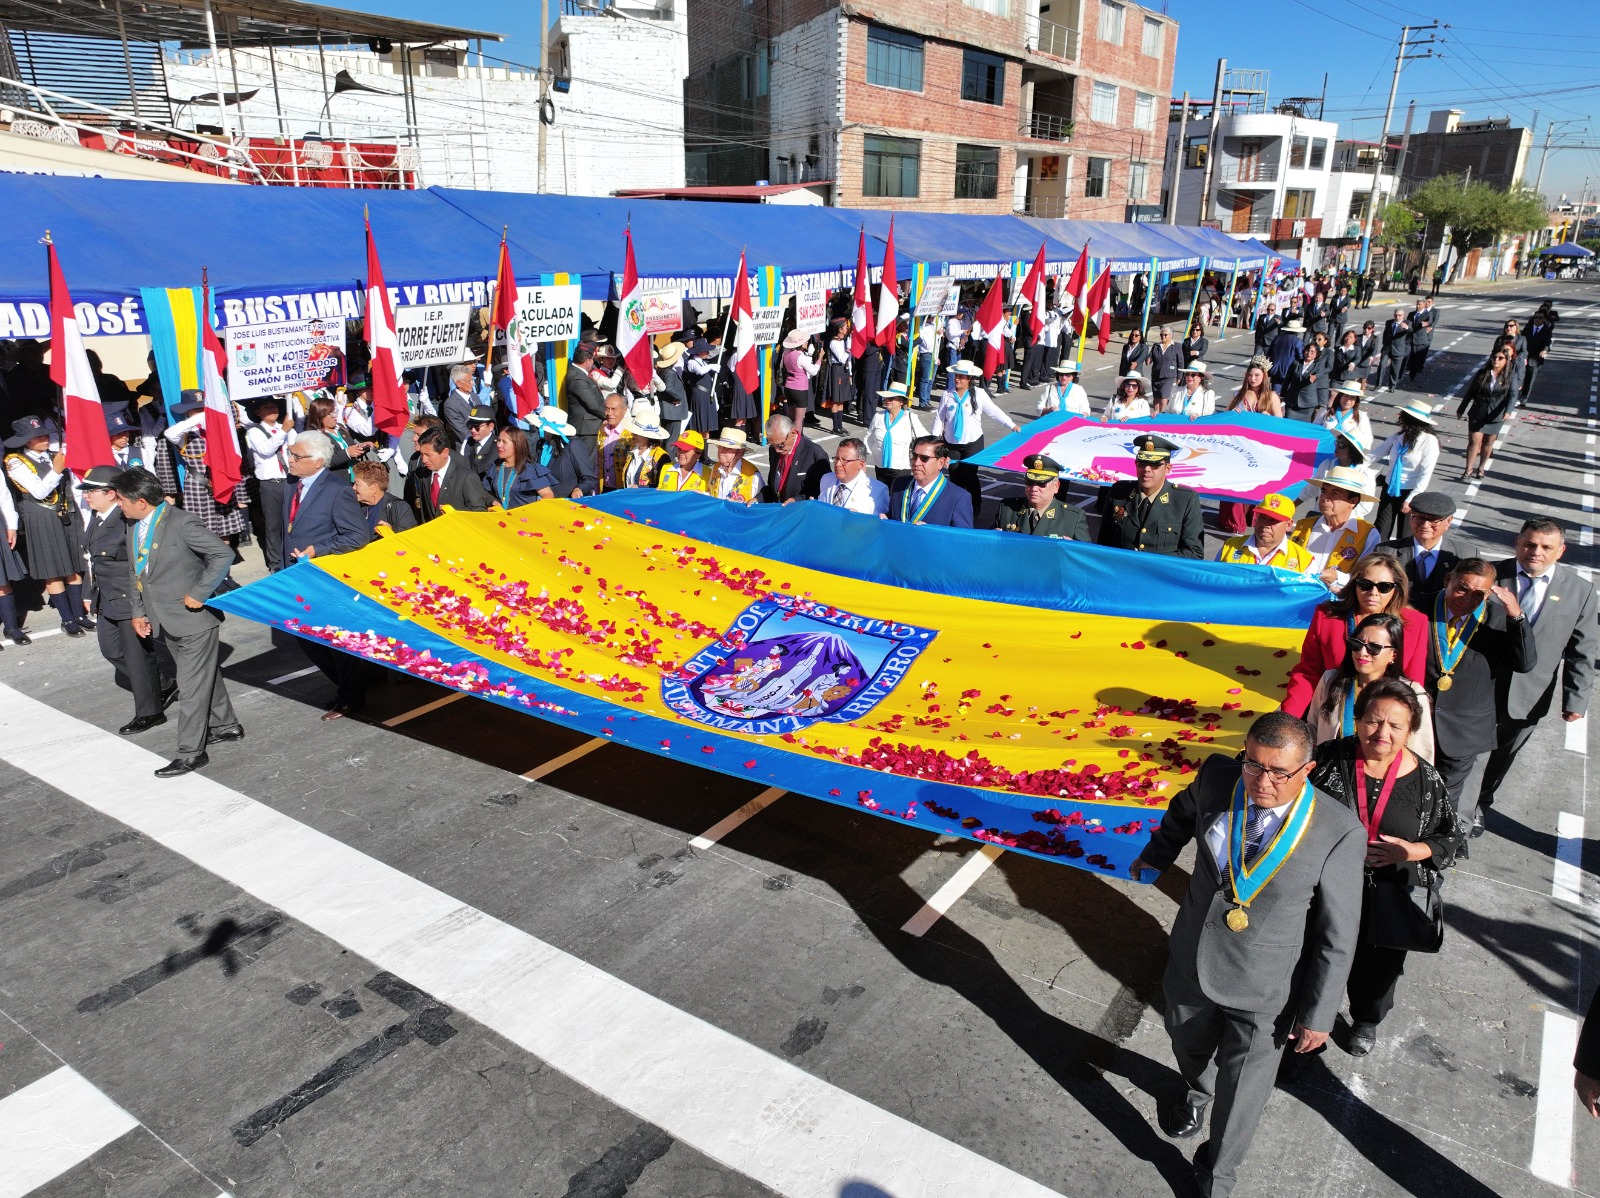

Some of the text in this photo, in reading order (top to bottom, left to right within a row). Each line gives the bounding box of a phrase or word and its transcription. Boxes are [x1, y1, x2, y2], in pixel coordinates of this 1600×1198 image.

[949, 263, 998, 280] MUNICIPALIDAD
[528, 291, 545, 304] I.E.
[804, 292, 821, 302] COLEGIO
[75, 297, 143, 335] OSÉ
[222, 287, 401, 328] BUSTAMANE
[424, 311, 444, 322] I.E.P.
[521, 306, 574, 322] ACULADA
[233, 331, 251, 340] JOSE
[251, 329, 267, 338] LUIS
[267, 325, 312, 336] BUSTAMANTE
[317, 322, 340, 331] RIVERO
[398, 322, 466, 347] TORRE FUERTE
[524, 320, 573, 338] CEPCIÓN
[263, 335, 340, 350] INSTITUCIÓN EDUCATIVA
[281, 350, 310, 361] 40175
[425, 345, 459, 359] KENNEDY
[276, 359, 337, 373] LIBERTADOR
[248, 375, 281, 387] SIMÓN
[261, 380, 318, 393] NIVEL PRIMARIA
